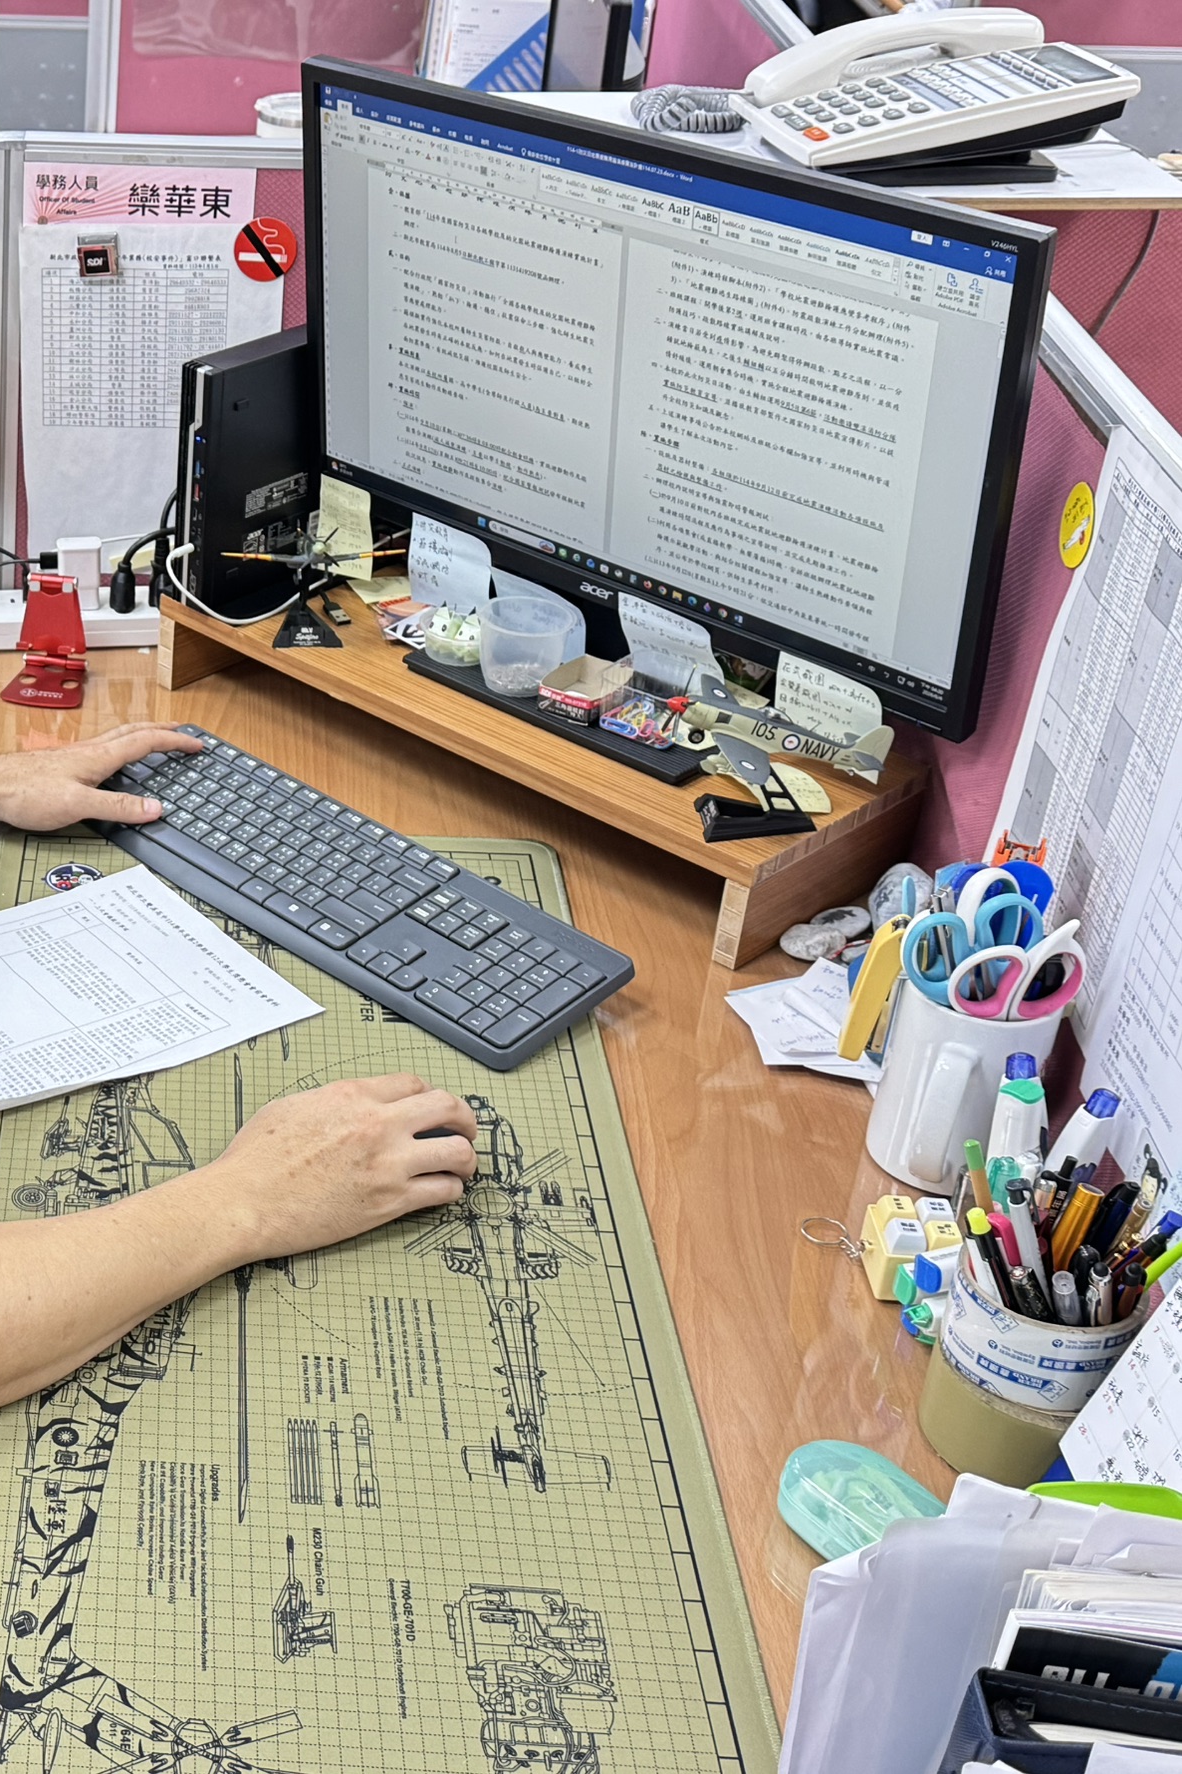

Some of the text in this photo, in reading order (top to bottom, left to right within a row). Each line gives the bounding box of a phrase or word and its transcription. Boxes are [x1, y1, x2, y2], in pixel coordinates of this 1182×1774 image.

[35, 174, 99, 192] 學務人員
[39, 195, 60, 204] Officer
[127, 183, 233, 219] 欒華東
[667, 201, 691, 218] AaB
[694, 209, 718, 226] AaBb
[86, 257, 104, 267] SDI
[579, 580, 614, 601] acer
[750, 720, 780, 742] 105
[799, 737, 841, 762] NAVY
[339, 1357, 351, 1395] Armament
[209, 1463, 221, 1502] Upgrades
[45, 1499, 68, 1535] 陸軍
[312, 1527, 326, 1597] M230 Chain Gun
[400, 1579, 416, 1642] T700-GE-701D
[119, 1729, 134, 1751] 64E
